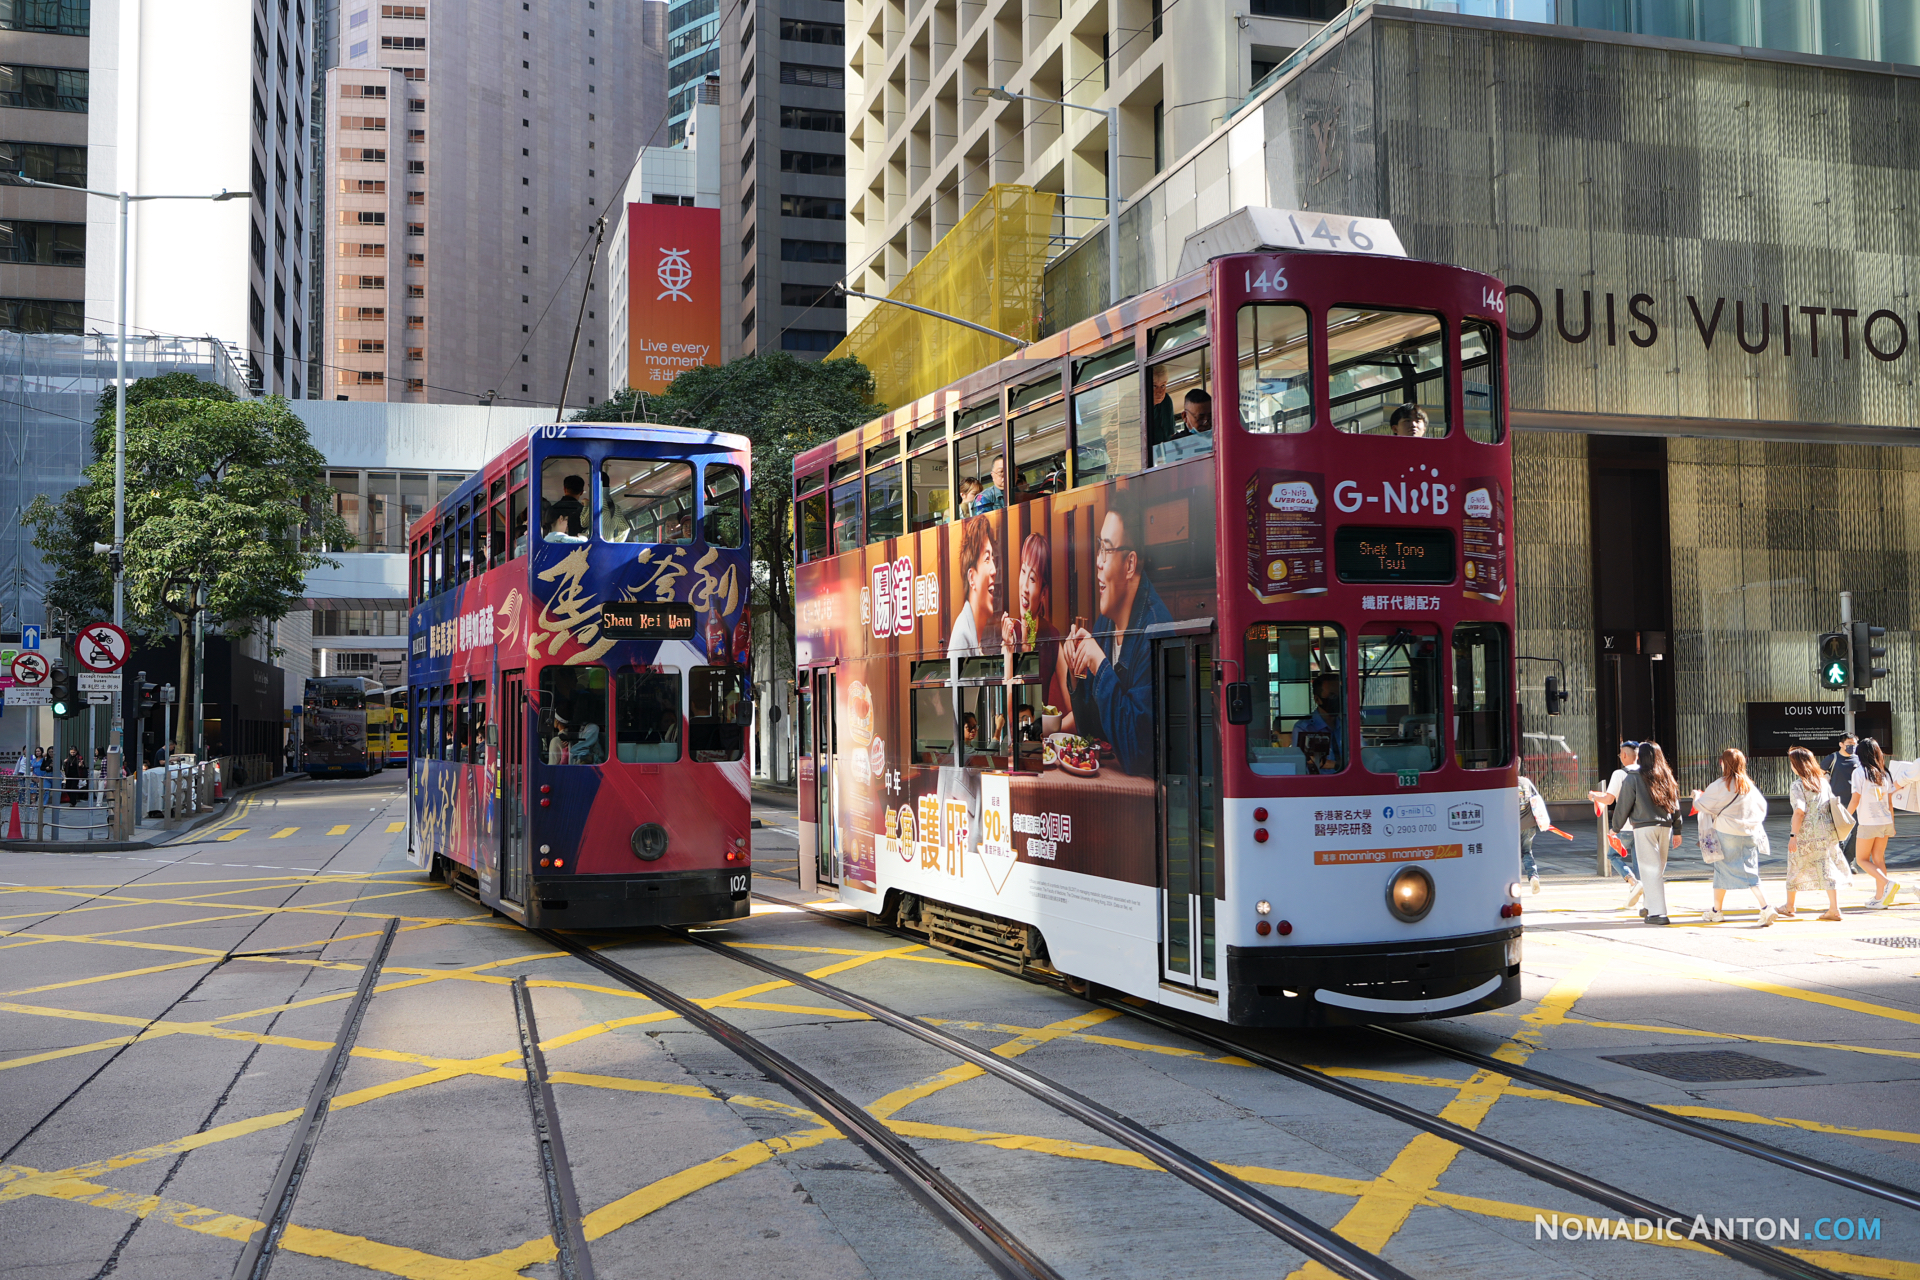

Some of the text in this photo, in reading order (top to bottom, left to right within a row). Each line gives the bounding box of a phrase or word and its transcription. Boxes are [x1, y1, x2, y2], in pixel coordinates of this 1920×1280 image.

[1288, 213, 1374, 251] 146
[1244, 267, 1289, 293] 146
[1482, 286, 1504, 314] 146
[1504, 284, 1920, 362] OUIS VUITTO
[640, 338, 710, 357] Live every
[645, 355, 705, 367] moment
[541, 425, 567, 439] 102
[1360, 542, 1425, 557] Shek Tong
[1378, 556, 1406, 570] Tsui
[1361, 595, 1441, 611] 纖肝代謝配方
[603, 613, 691, 630] Shau Kei Wan
[1784, 706, 1854, 716] LOUIS VUITTO
[885, 768, 901, 796] 中年
[1398, 775, 1417, 787] 033
[1314, 809, 1372, 821] 香港著名大學
[1401, 808, 1421, 816] g-niib
[1314, 822, 1372, 837] 醫學院研發
[1397, 824, 1437, 834] 2903 0700
[1339, 850, 1386, 862] mannings
[1392, 848, 1434, 860] mannings
[1467, 843, 1483, 855] 有售
[730, 875, 747, 892] 102
